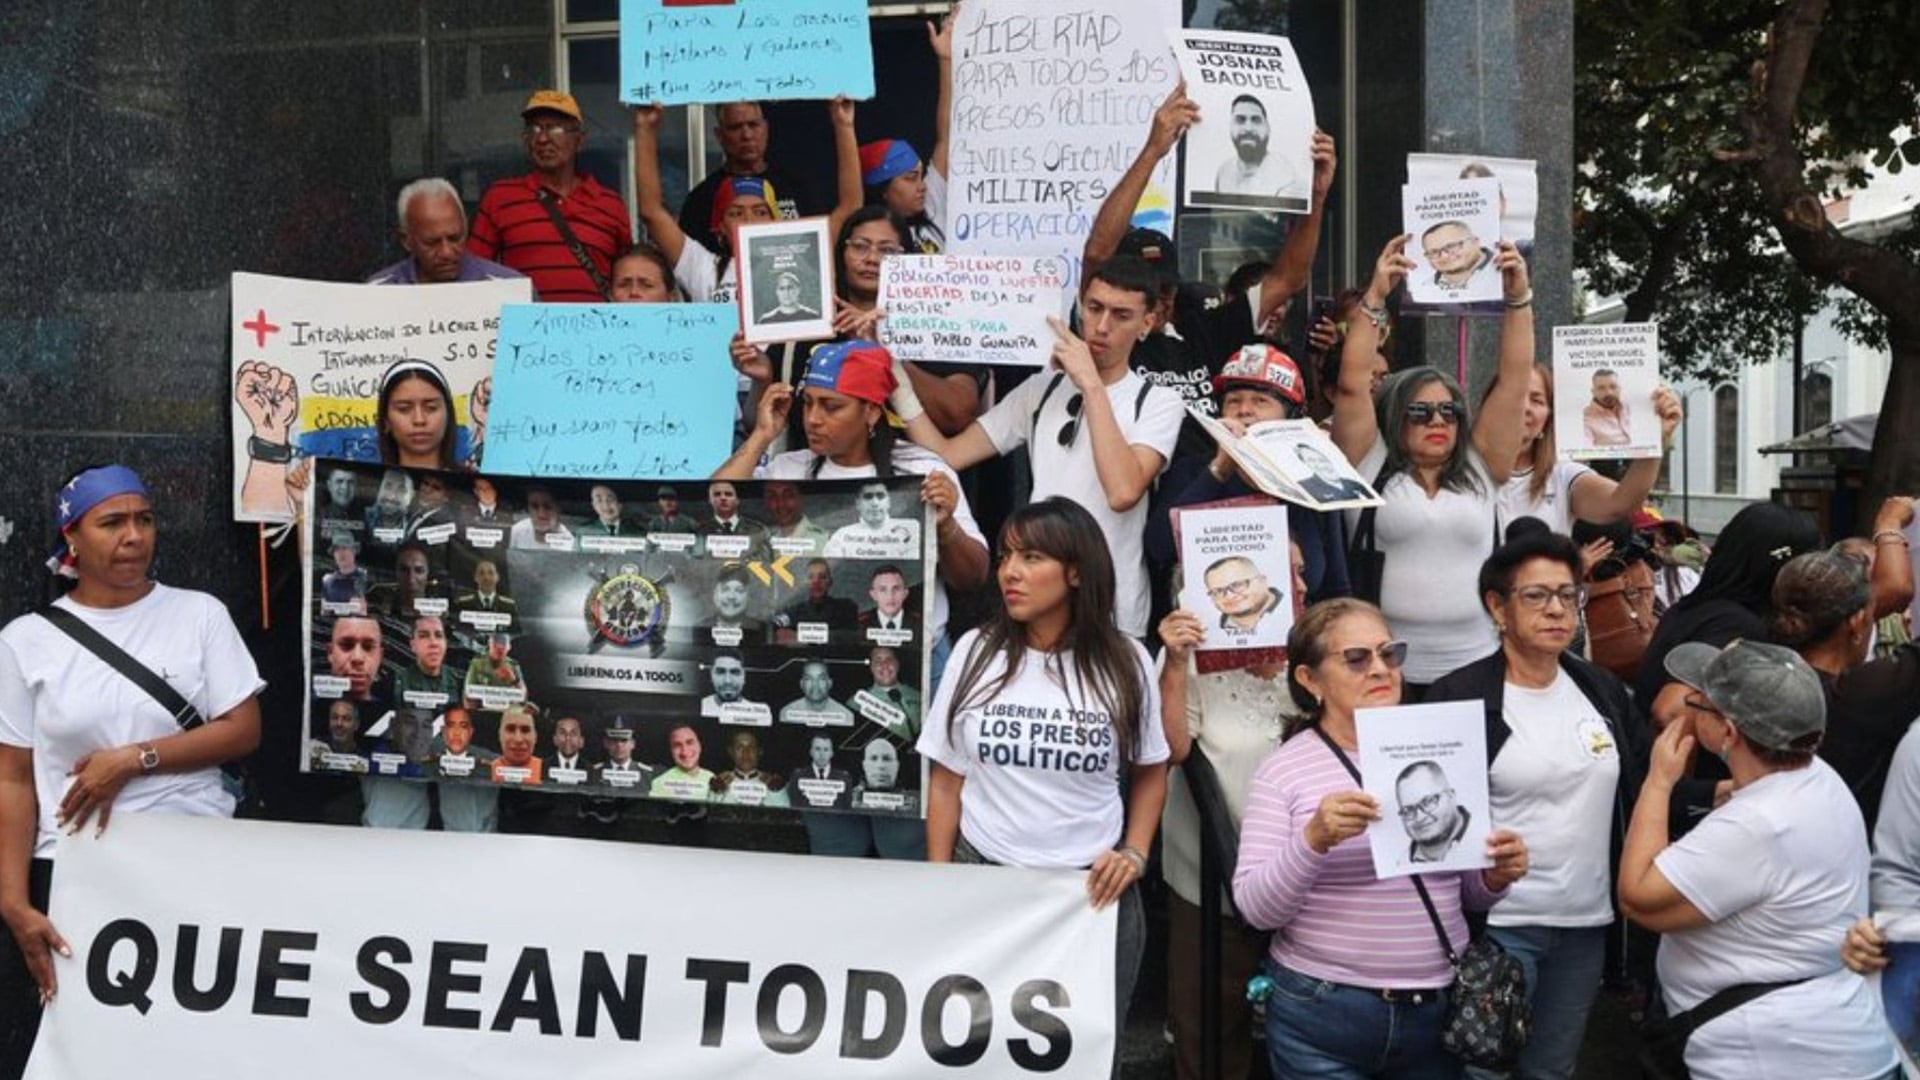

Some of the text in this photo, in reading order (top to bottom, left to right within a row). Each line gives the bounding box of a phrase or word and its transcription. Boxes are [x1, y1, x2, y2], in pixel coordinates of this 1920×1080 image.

[1197, 52, 1285, 73] JOSNAR
[955, 60, 1018, 97] PARA
[1022, 56, 1110, 86] TODOS
[1201, 69, 1292, 91] BADUEL
[953, 94, 1046, 132] PRESOS
[1043, 139, 1139, 172] OFICIALE
[967, 178, 1108, 213] MILITARES
[1423, 191, 1480, 202] LIBERTAD
[888, 270, 990, 285] OBLIGATORIO
[885, 317, 1008, 333] LIBERTAD PARA
[1605, 325, 1656, 335] LIBERTAD
[882, 330, 1038, 349] JUAN PABLO GUANIPA
[1195, 533, 1274, 545] PARA DENYS
[1203, 524, 1265, 535] LIBERTAD
[634, 668, 644, 680] A
[645, 670, 684, 683] TODOS
[1052, 708, 1063, 720] A
[980, 719, 1112, 747] LOS PRESOS
[978, 741, 1110, 774] POLÍTICOS
[85, 917, 1074, 1073] QUE SEAN TODOS
